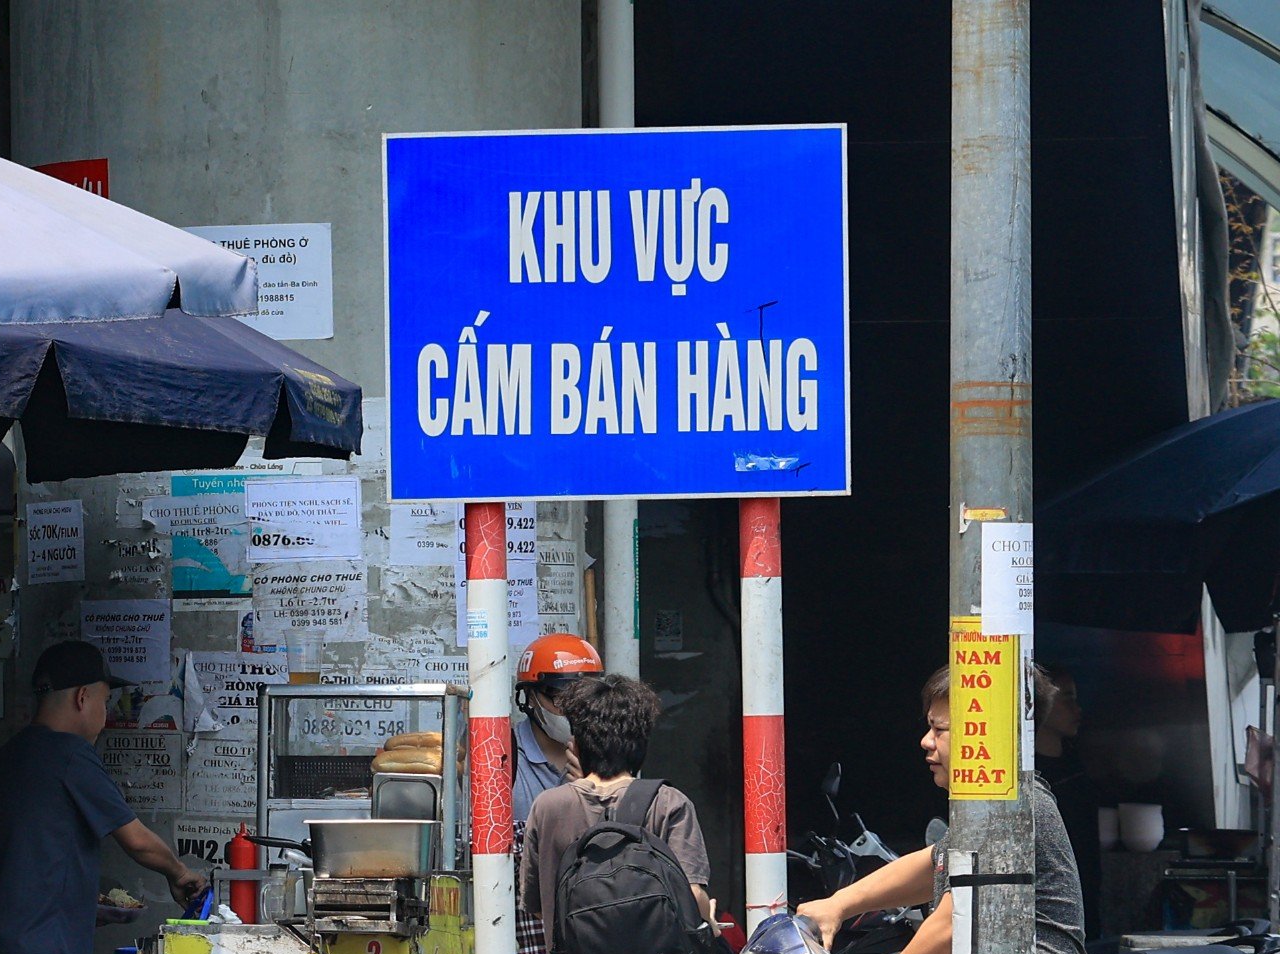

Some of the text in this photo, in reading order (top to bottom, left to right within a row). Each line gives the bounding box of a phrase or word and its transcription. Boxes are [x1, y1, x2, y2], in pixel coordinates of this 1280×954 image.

[254, 237, 295, 249] PHÒNG
[299, 236, 310, 248] Ở
[509, 178, 729, 296] KHU VỰC
[418, 310, 818, 437] CẤM BÁN HÀNG
[150, 508, 170, 518] CHO
[992, 541, 1020, 552] CHO
[270, 573, 307, 584] PHÒNG
[310, 574, 332, 582] CHO
[336, 572, 363, 581] THUÊ
[311, 609, 326, 617] 319
[291, 619, 311, 627] 0399
[329, 618, 343, 626] 581
[956, 651, 1001, 665] NAM
[425, 662, 449, 671] CHO
[960, 669, 992, 690] MÔ
[245, 696, 259, 706] R
[967, 698, 983, 713] A
[964, 722, 987, 737] DI
[133, 734, 166, 748] THUÊ
[960, 741, 992, 761] ĐÀ
[952, 764, 1006, 789] PHẬT
